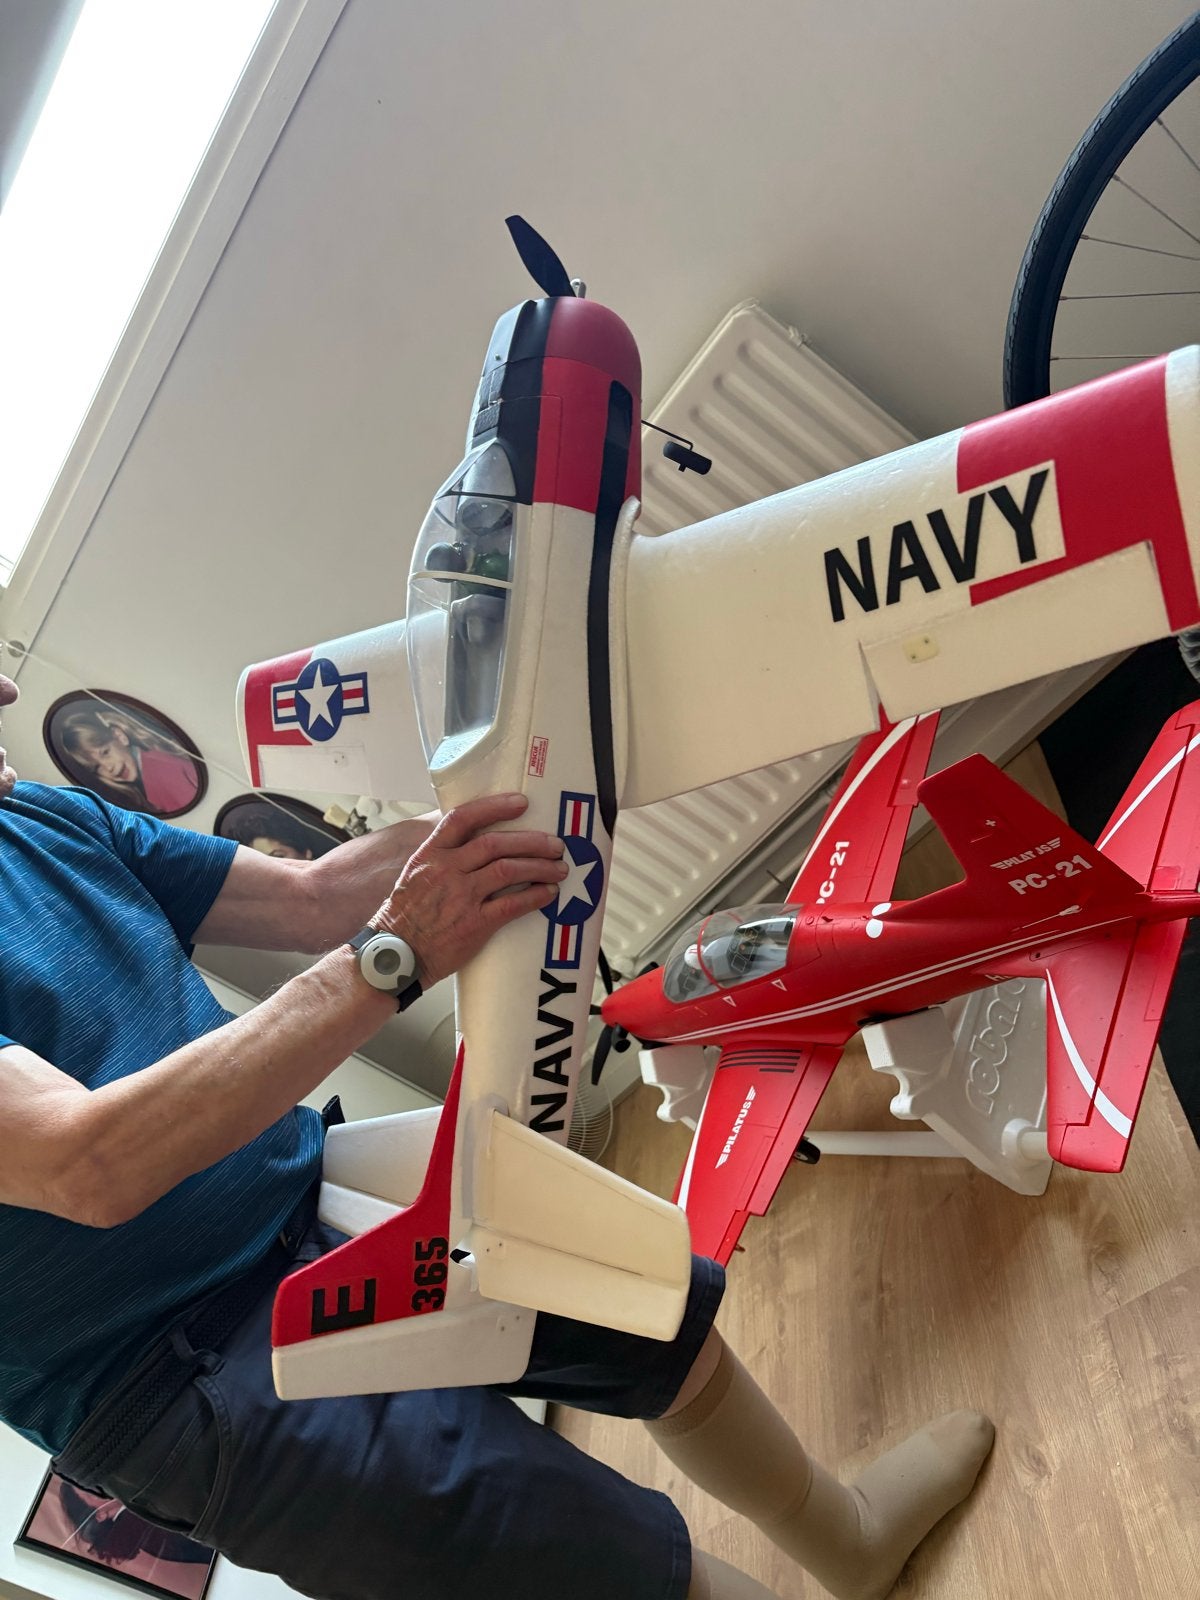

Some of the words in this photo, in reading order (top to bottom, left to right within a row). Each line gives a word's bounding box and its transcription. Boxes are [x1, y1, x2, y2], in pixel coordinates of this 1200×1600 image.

[824, 468, 1049, 623] NAVY
[1008, 854, 1093, 895] PC-21
[529, 968, 577, 1133] NAVY
[721, 1100, 752, 1154] PILATUS
[310, 1278, 377, 1336] E
[411, 1237, 449, 1312] 365
